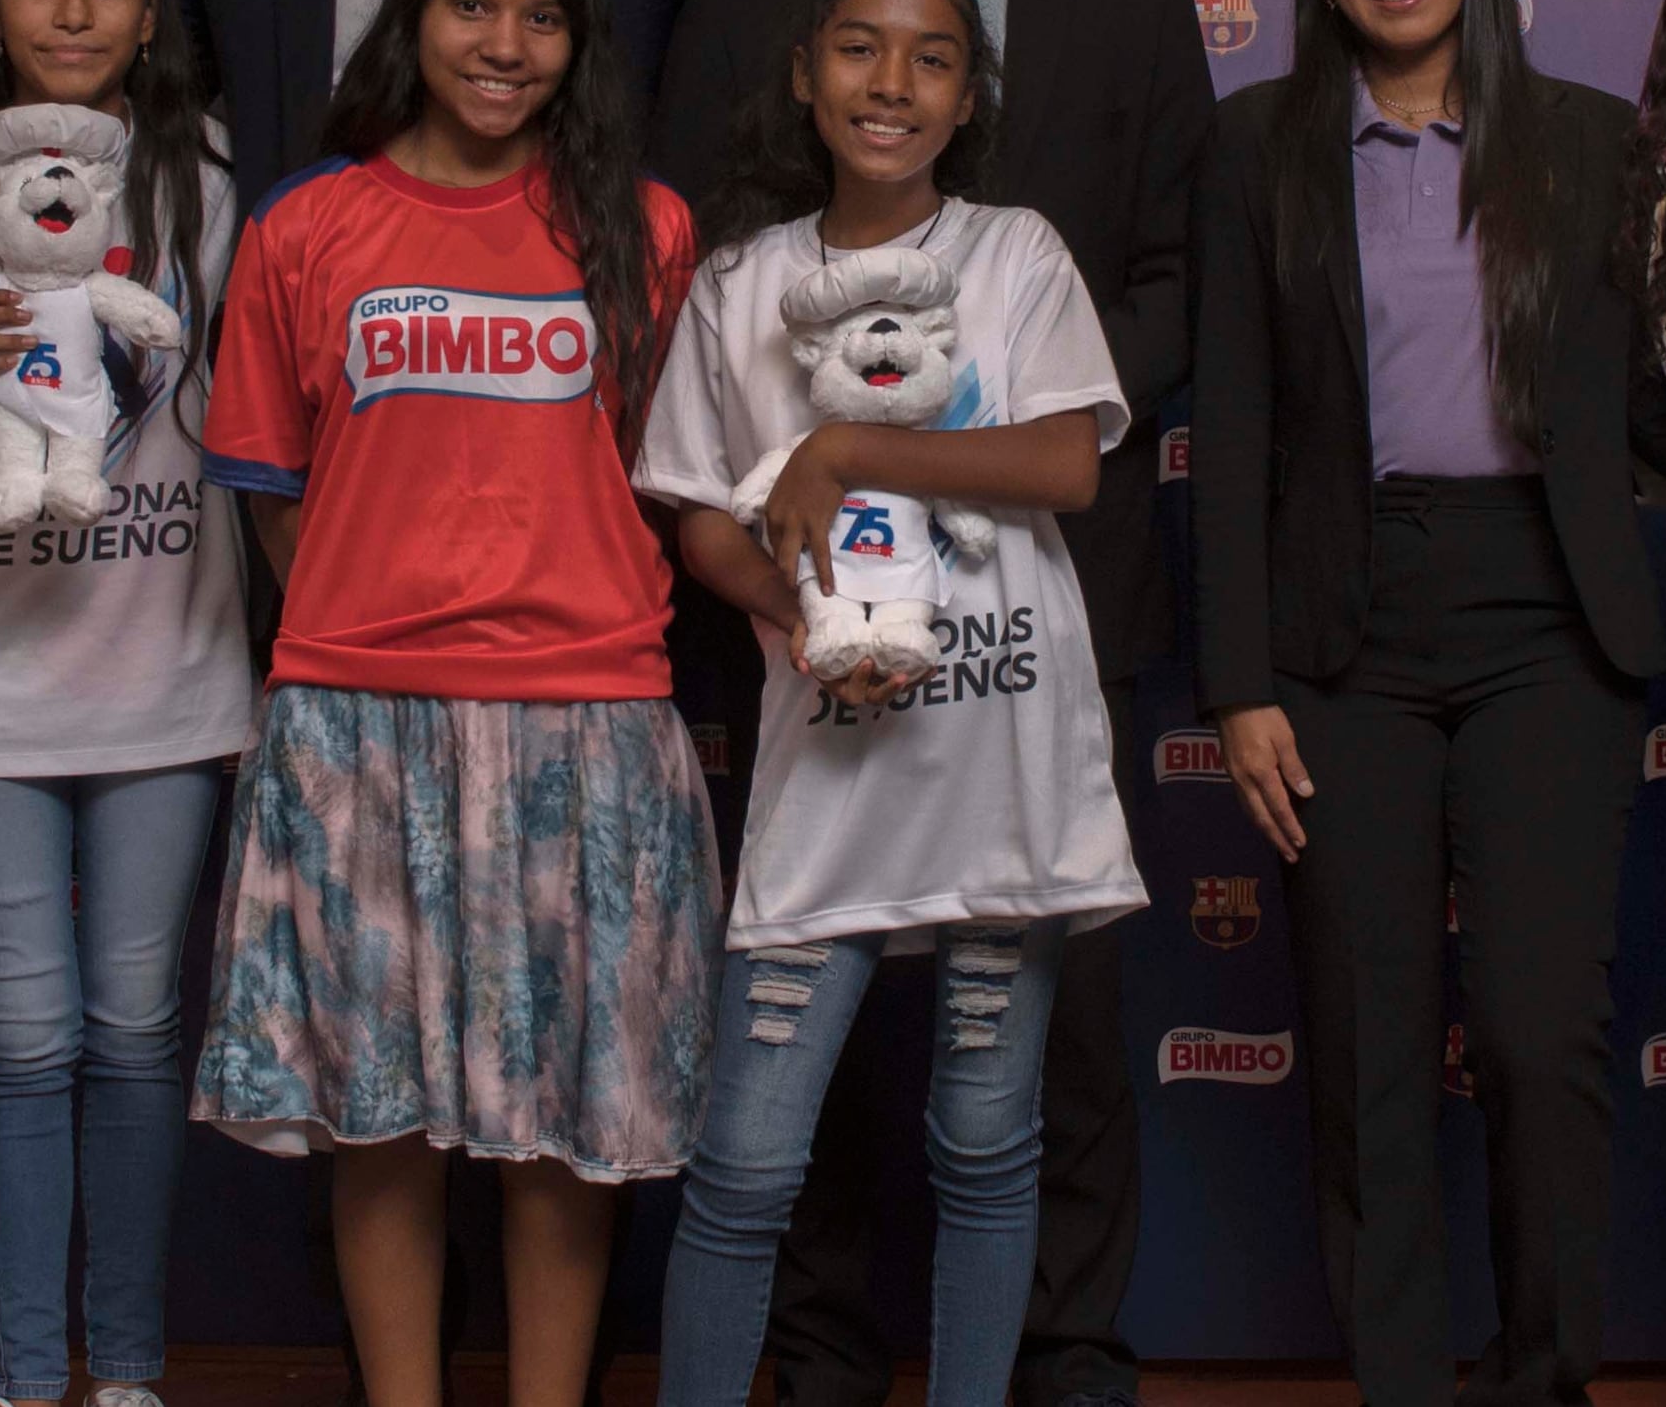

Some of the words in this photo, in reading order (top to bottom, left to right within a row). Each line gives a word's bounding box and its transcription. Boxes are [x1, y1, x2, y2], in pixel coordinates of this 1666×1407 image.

[361, 295, 449, 318] GRUPO
[360, 316, 588, 379] BIMBO
[30, 513, 201, 566] SUEÑO
[839, 506, 894, 551] 75
[1165, 743, 1222, 770] BIM
[1170, 1032, 1215, 1043] GRUPO
[1171, 1043, 1286, 1072] BIMBO
